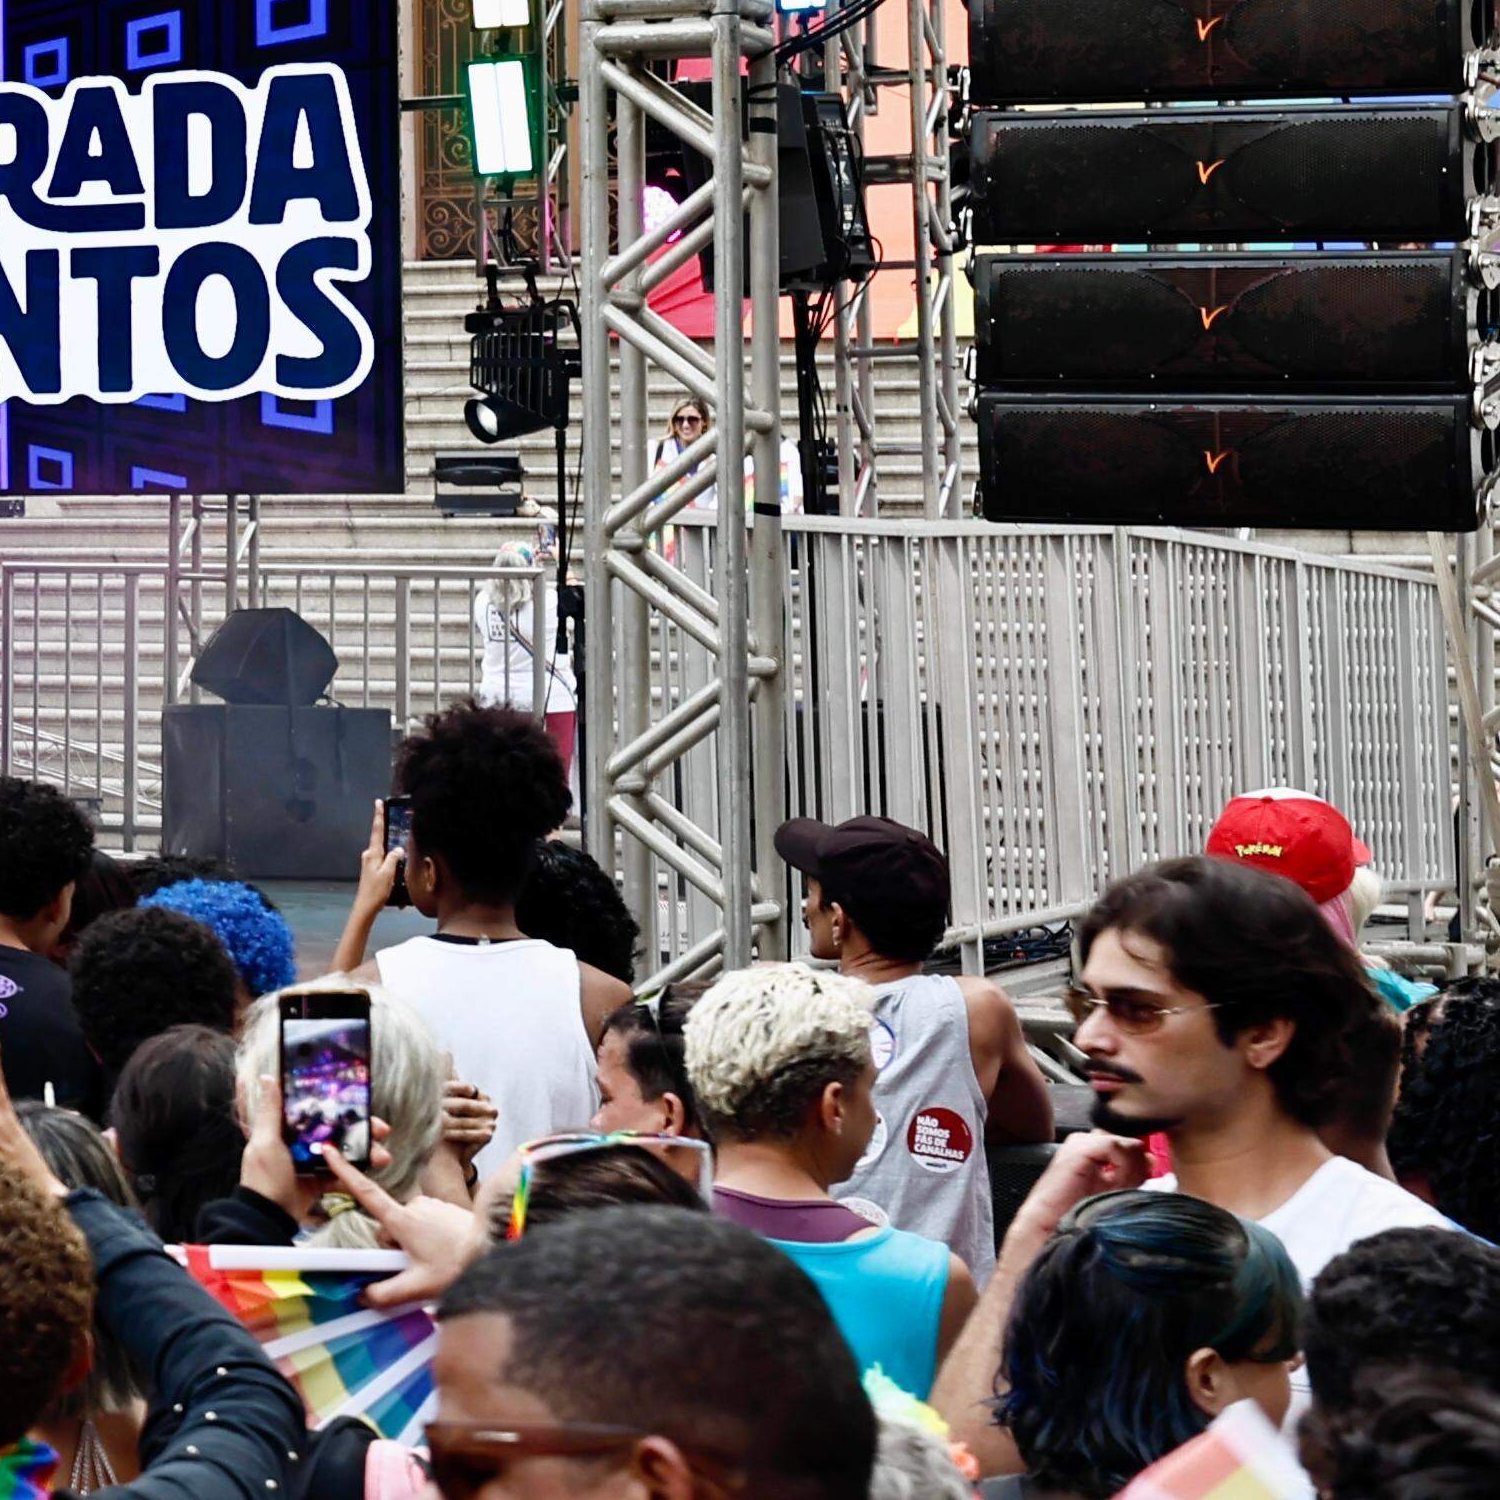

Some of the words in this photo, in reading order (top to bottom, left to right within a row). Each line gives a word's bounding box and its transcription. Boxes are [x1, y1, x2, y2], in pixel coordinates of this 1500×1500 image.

[916, 1114, 939, 1128] NÃO
[916, 1125, 950, 1139] SOMOS
[934, 1137, 948, 1148] DE
[914, 1143, 965, 1160] CANALHAS
